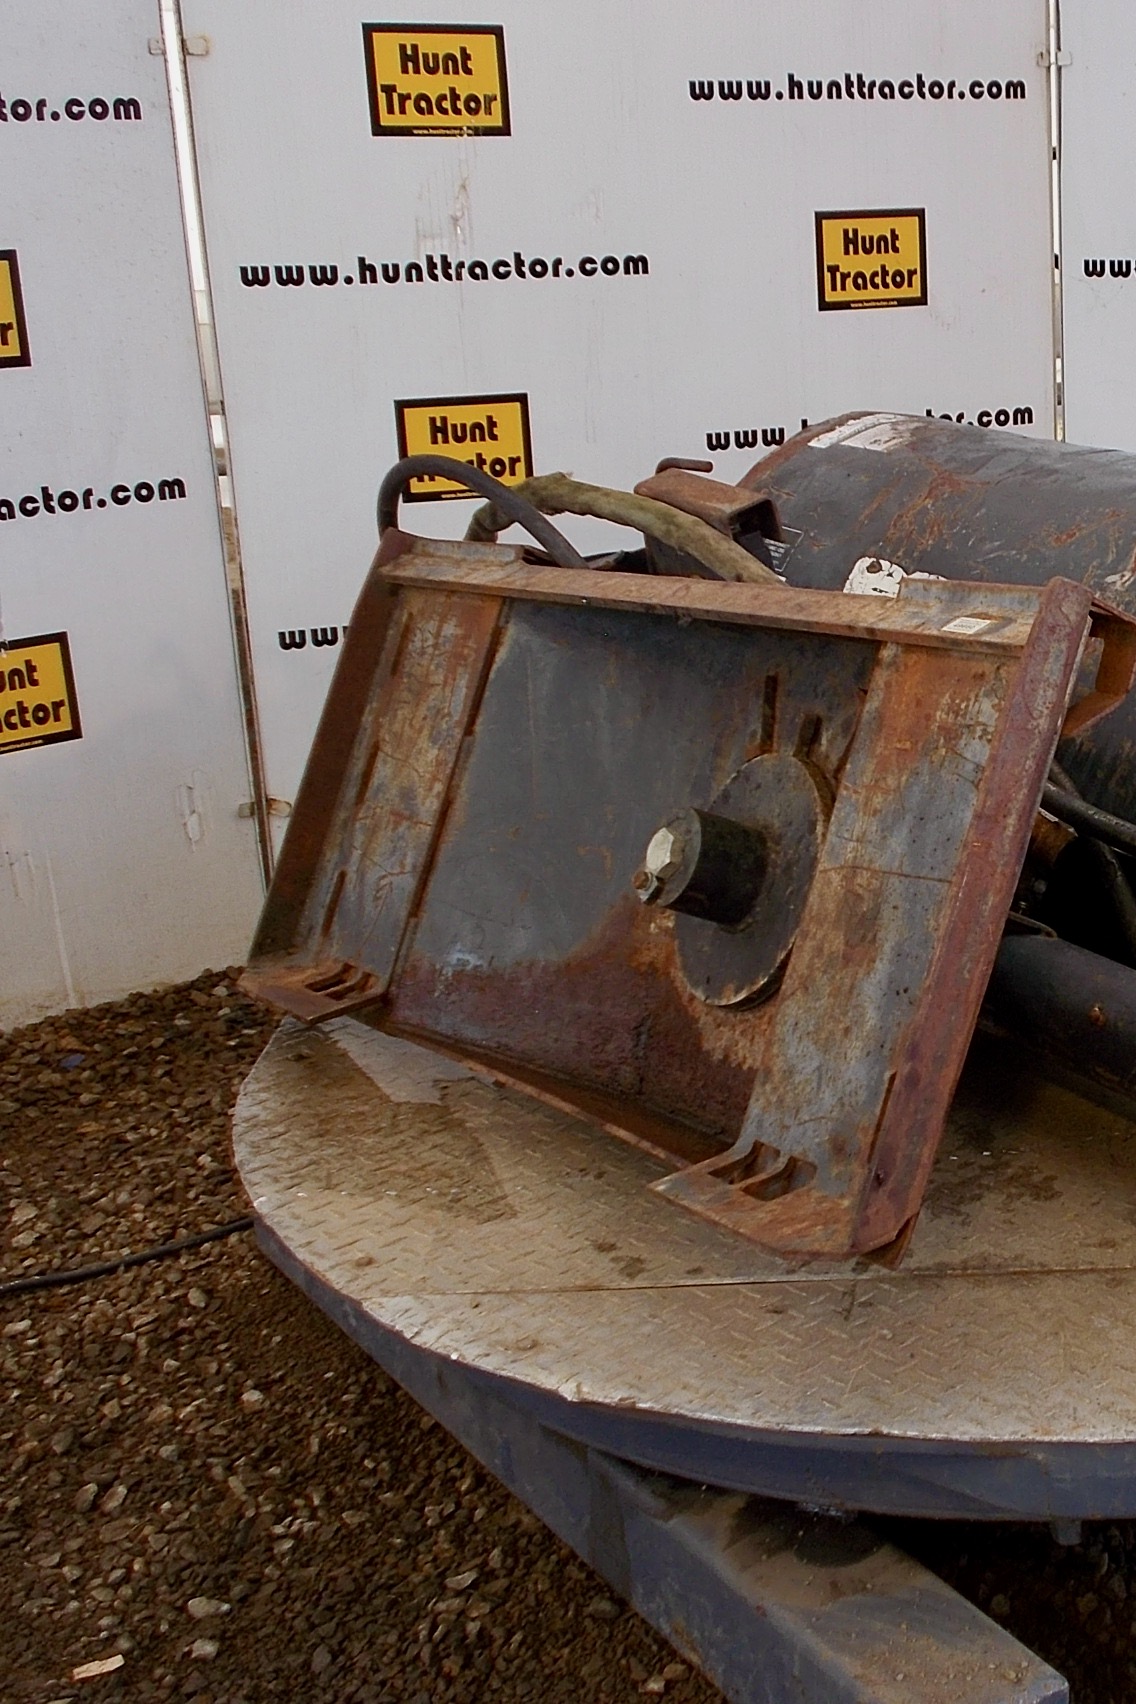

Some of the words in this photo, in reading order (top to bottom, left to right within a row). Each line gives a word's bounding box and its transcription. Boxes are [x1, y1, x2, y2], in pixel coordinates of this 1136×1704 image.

[399, 43, 473, 75] Hunt
[380, 83, 498, 116] Tractor
[689, 73, 1026, 101] www.hunttractor.com
[842, 228, 899, 255] Hunt
[240, 252, 649, 288] www.hunttractor.com
[826, 264, 918, 293] Tractor
[428, 415, 499, 445] Hunt
[0, 699, 66, 734] ctor
